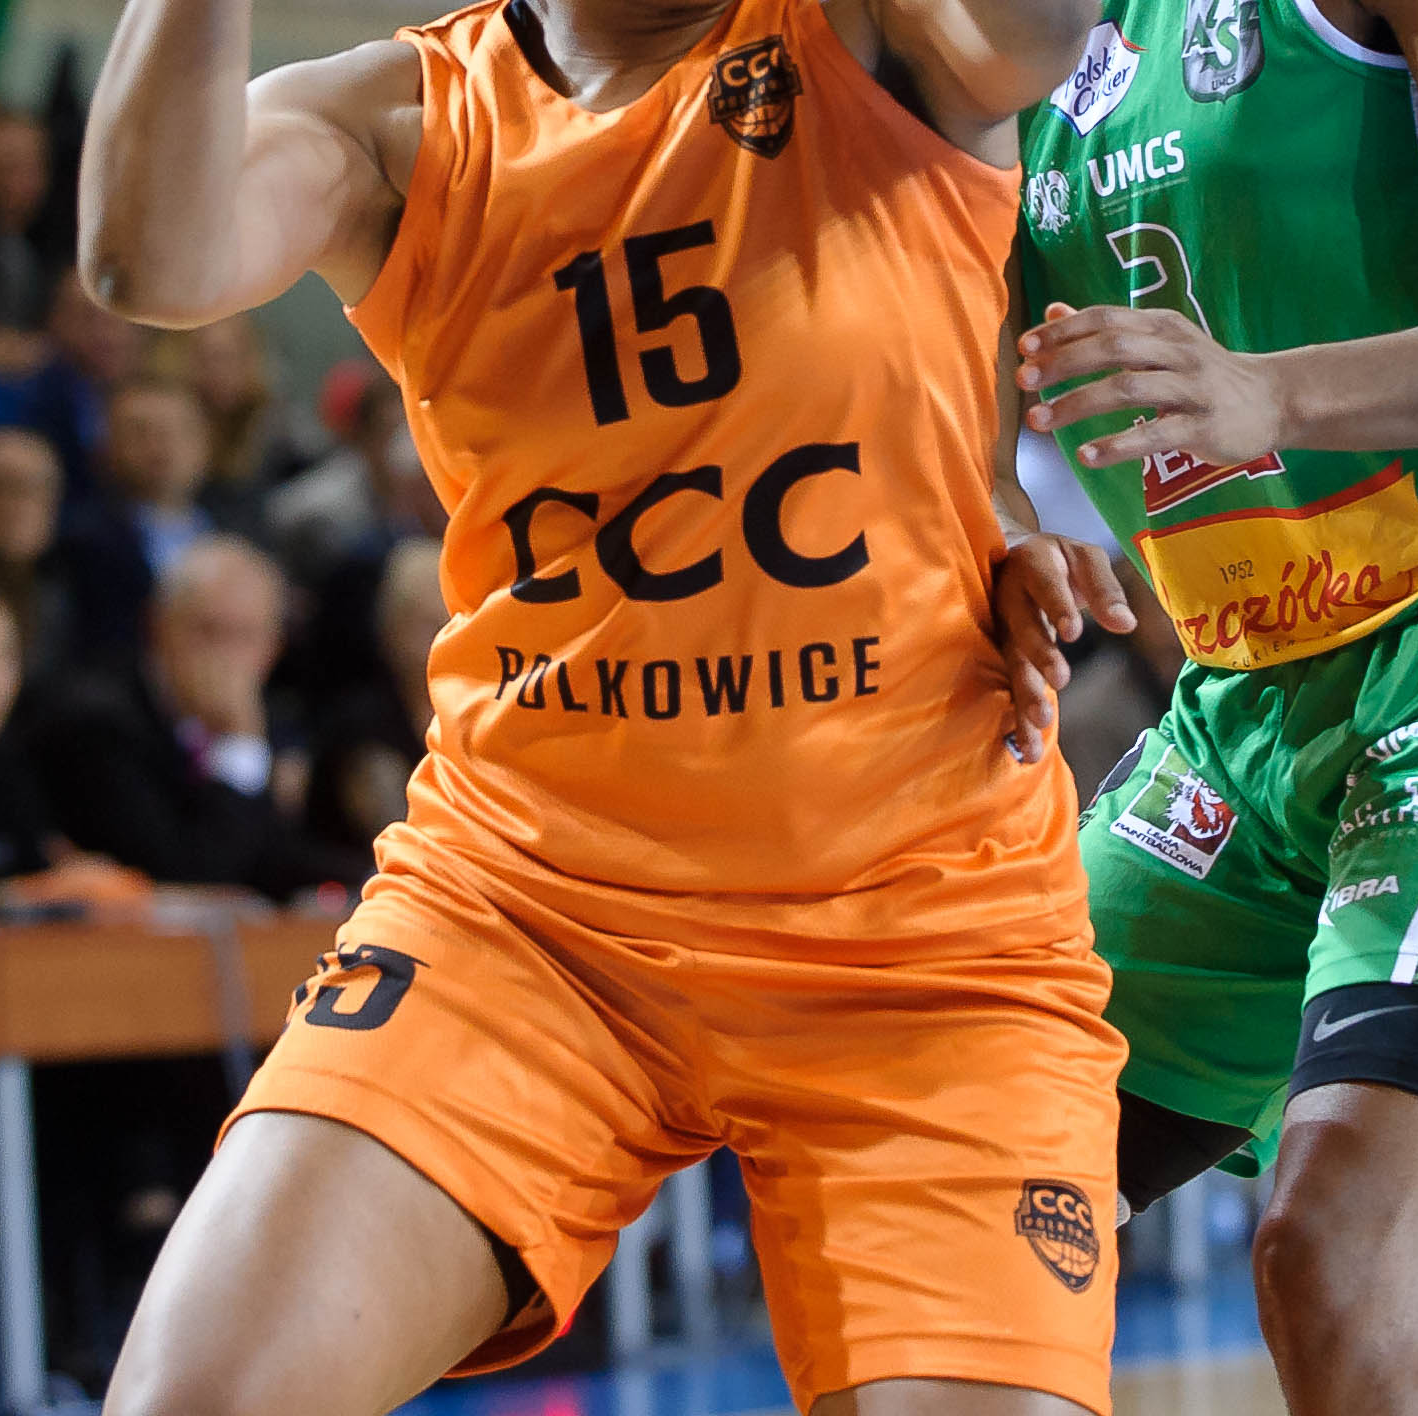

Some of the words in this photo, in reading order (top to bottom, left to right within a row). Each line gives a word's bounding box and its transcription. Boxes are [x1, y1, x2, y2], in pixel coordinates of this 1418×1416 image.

[1087, 130, 1185, 197] UMCS
[554, 220, 741, 426] 15
[502, 442, 870, 604] CCC
[1219, 559, 1254, 585] 1952
[494, 636, 882, 721] POLKOWICE
[1115, 822, 1203, 874] PAINTBALLOWA
[1147, 827, 1180, 851] LEGIA
[1032, 1189, 1092, 1230] CCC
